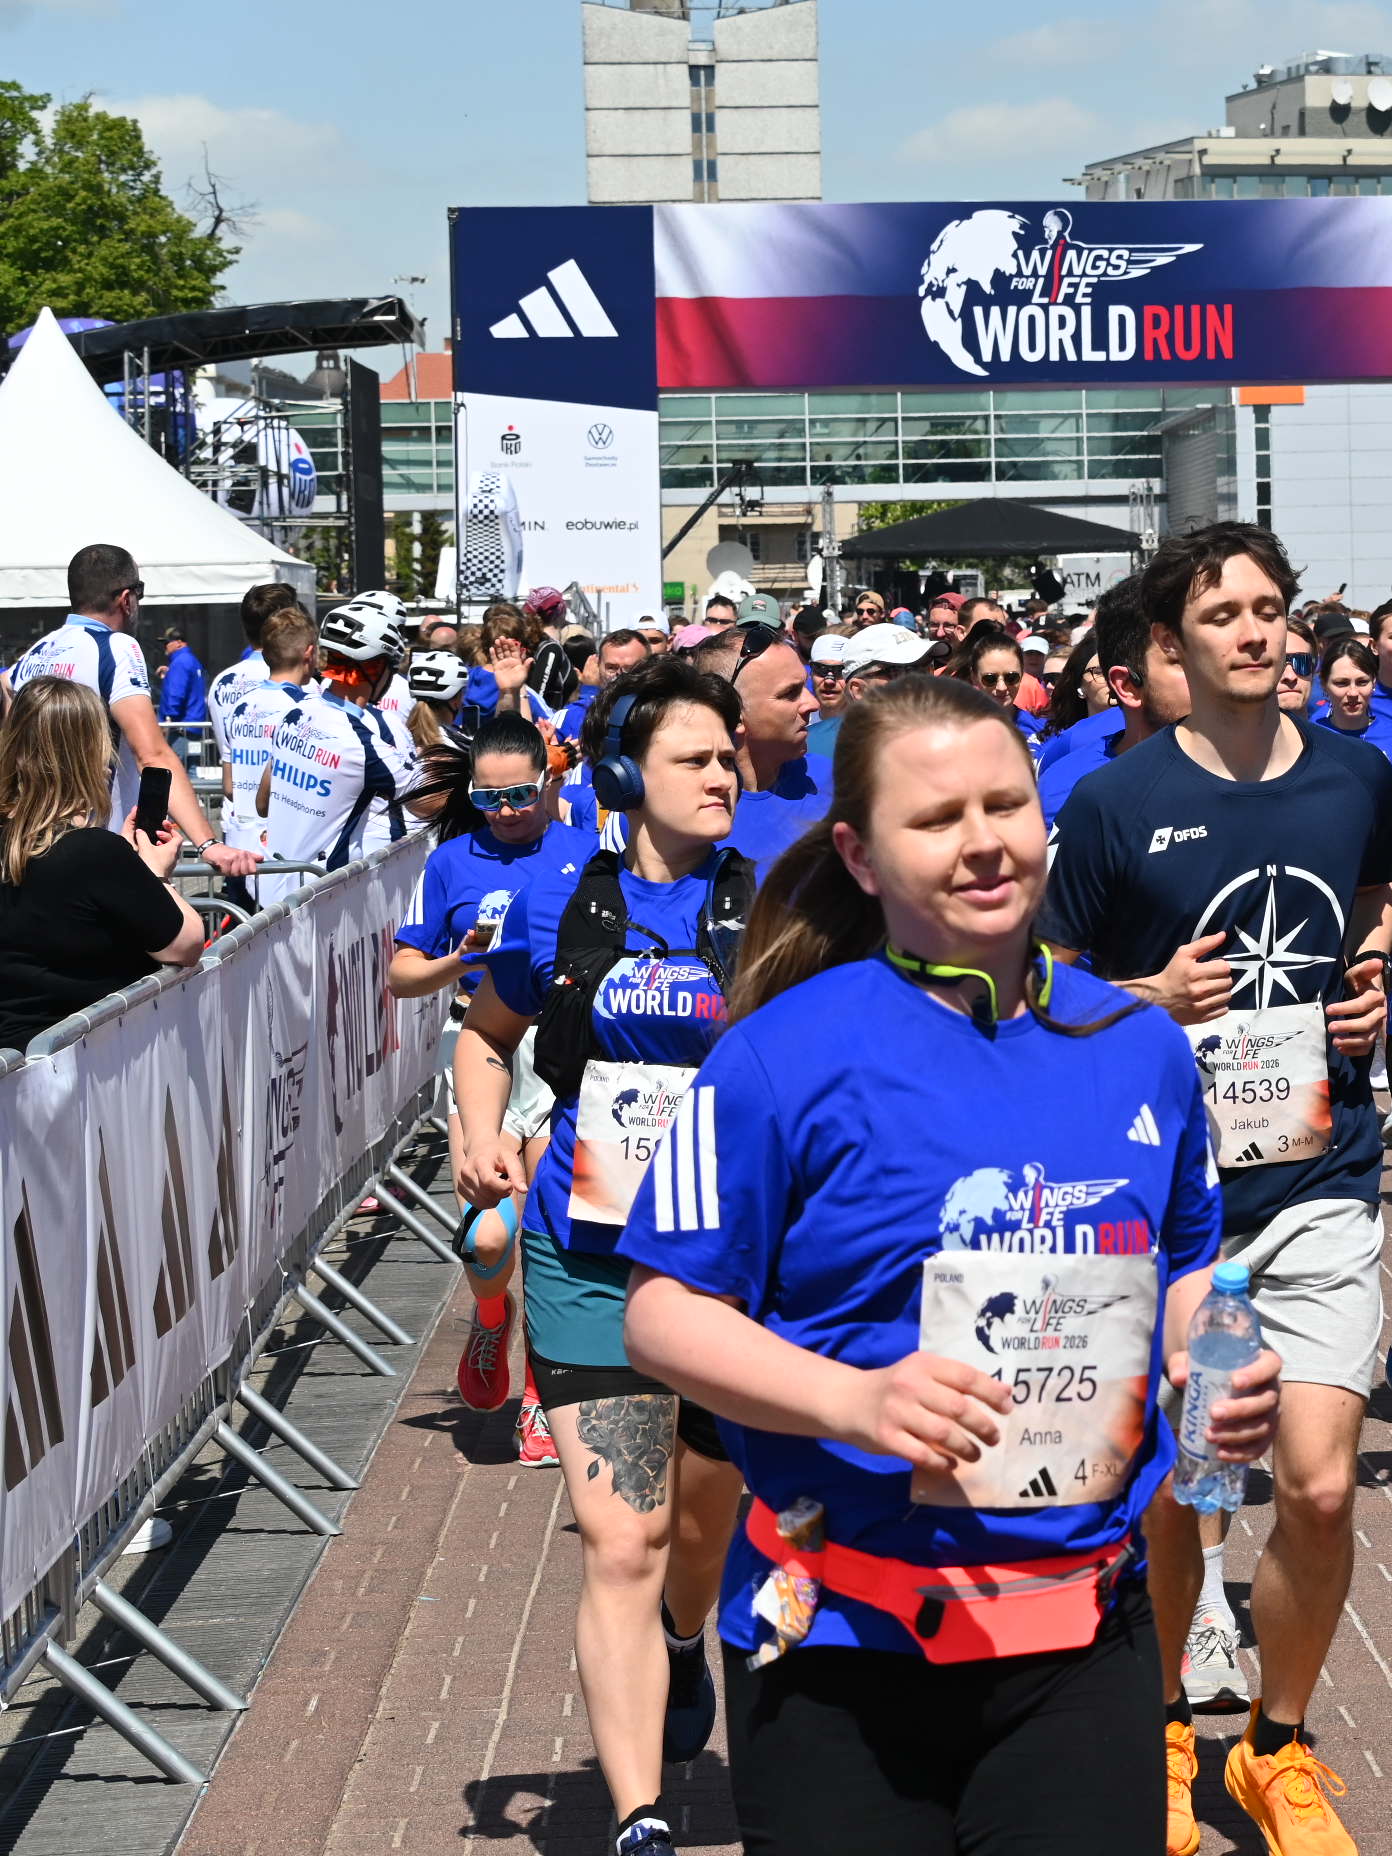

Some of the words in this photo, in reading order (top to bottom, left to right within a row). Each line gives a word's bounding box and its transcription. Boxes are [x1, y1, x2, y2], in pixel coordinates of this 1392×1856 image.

[1016, 246, 1130, 277] WINGS
[1010, 277, 1035, 291] FOR
[1031, 276, 1099, 304] LIFE
[972, 305, 1137, 363] WORLD
[1143, 304, 1235, 361] RUN
[566, 518, 639, 531] eobuwie.pl
[580, 583, 629, 593] ntinental
[221, 691, 246, 705] WOR
[234, 723, 263, 739] WORLD
[263, 724, 276, 739] RU
[232, 748, 272, 766] HILIP
[281, 731, 316, 760] WORLD
[315, 748, 341, 769] RUN
[272, 756, 332, 797] HILIPS
[281, 794, 327, 818] Headphones
[1173, 825, 1208, 843] DFDS
[1267, 864, 1277, 877] N
[632, 965, 690, 981] WINGS
[639, 978, 672, 991] LIFE
[609, 988, 692, 1018] WORLD
[1225, 1036, 1275, 1049] WINGS
[1232, 1048, 1261, 1061] LIFE
[1213, 1061, 1242, 1072] WORLD
[1242, 1060, 1259, 1071] RUN
[1260, 1058, 1280, 1070] 2026
[643, 1092, 684, 1107] WING
[1207, 1077, 1291, 1105] 14539
[628, 1116, 657, 1128] WORLD
[657, 1118, 671, 1129] RU
[1230, 1116, 1270, 1131] Jakub
[620, 1135, 662, 1162] 15
[1277, 1134, 1289, 1153] 3
[1292, 1136, 1314, 1147] M-M
[1007, 1184, 1087, 1209] WINGS
[1005, 1209, 1023, 1222] FOR
[1021, 1206, 1068, 1230] LIFE
[1098, 1219, 1149, 1256] RUN
[934, 1273, 964, 1284] POLAND
[1022, 1298, 1088, 1316] WINGS
[1029, 1315, 1066, 1333] LIFE
[1001, 1336, 1041, 1351] WORLD
[1040, 1335, 1061, 1350] RUN
[1062, 1334, 1089, 1350] 2026
[1183, 1372, 1203, 1444] KINGA
[1019, 1427, 1063, 1447] Anna
[1073, 1458, 1088, 1487] 4
[1091, 1463, 1122, 1478] F-XL
